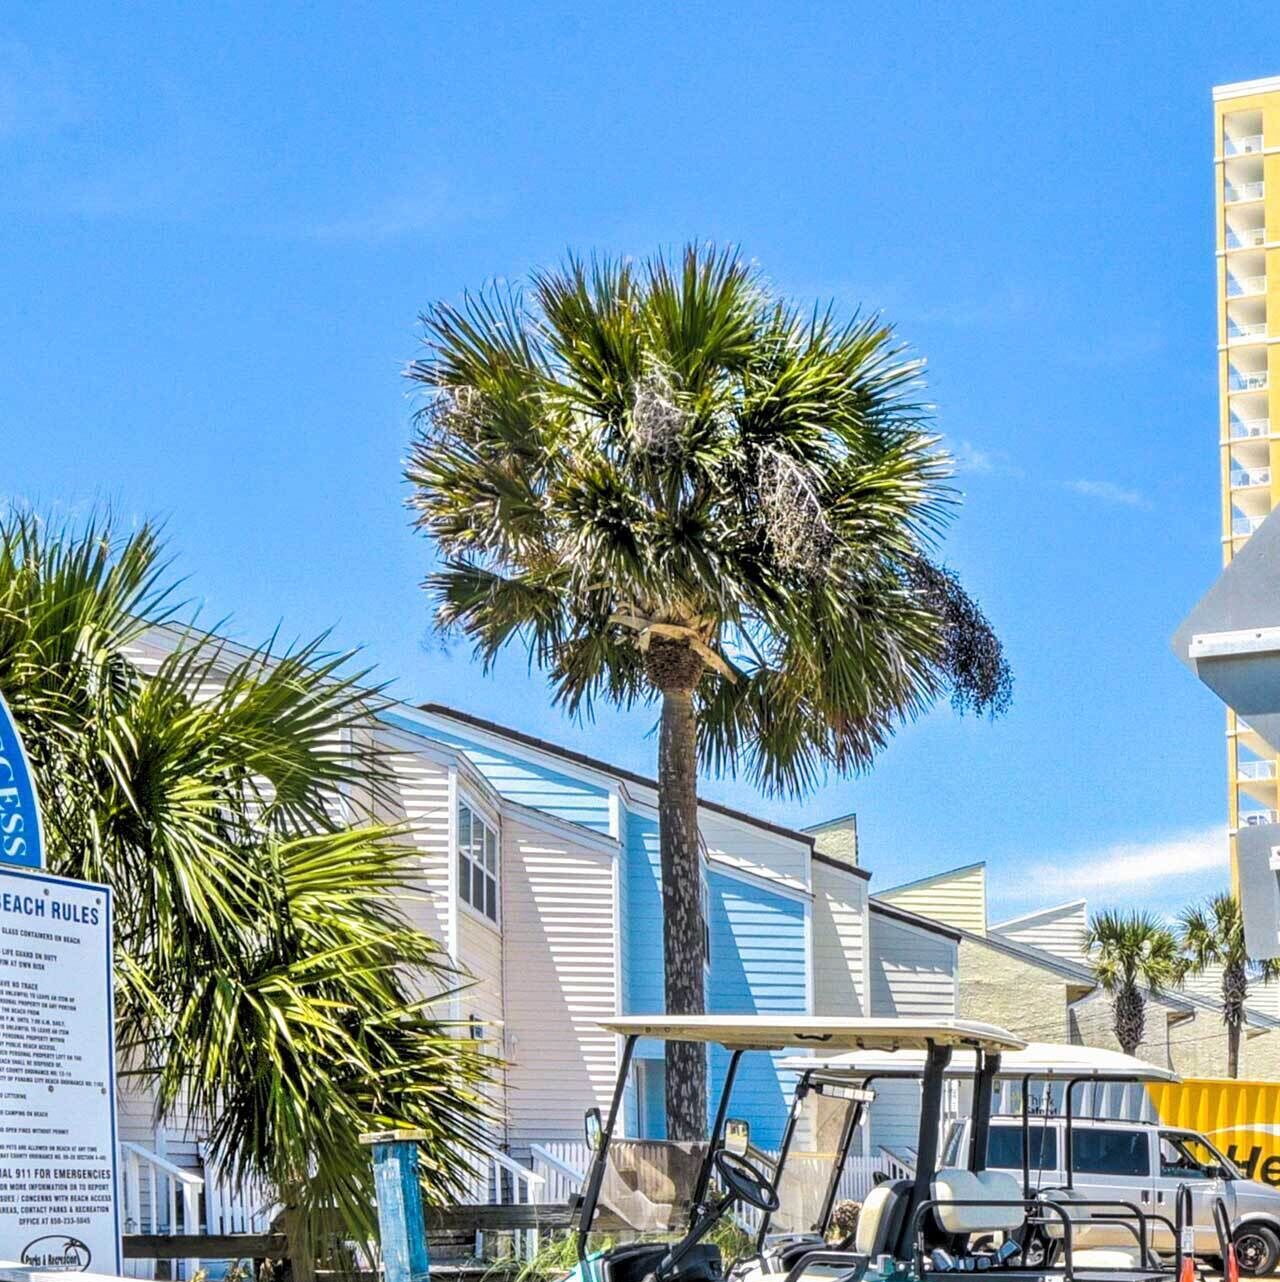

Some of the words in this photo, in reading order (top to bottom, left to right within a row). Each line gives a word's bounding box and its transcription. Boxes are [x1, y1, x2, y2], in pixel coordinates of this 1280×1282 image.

[52, 901, 99, 925] RULES
[2, 927, 19, 936] GLASS
[20, 929, 53, 940] CONTAINERS
[54, 934, 61, 942] ON
[63, 936, 80, 944] BEACH
[2, 948, 14, 956] LIFE
[15, 950, 33, 959] GUARD
[35, 952, 42, 960] ON
[43, 953, 57, 962] DUTY
[10, 959, 17, 967] AT
[18, 961, 31, 969] OWN
[33, 963, 45, 971] RISK
[21, 982, 38, 991] TRACE
[15, 1169, 31, 1179] 911
[34, 1169, 50, 1179] FOR
[54, 1169, 111, 1179] EMERGENCIES
